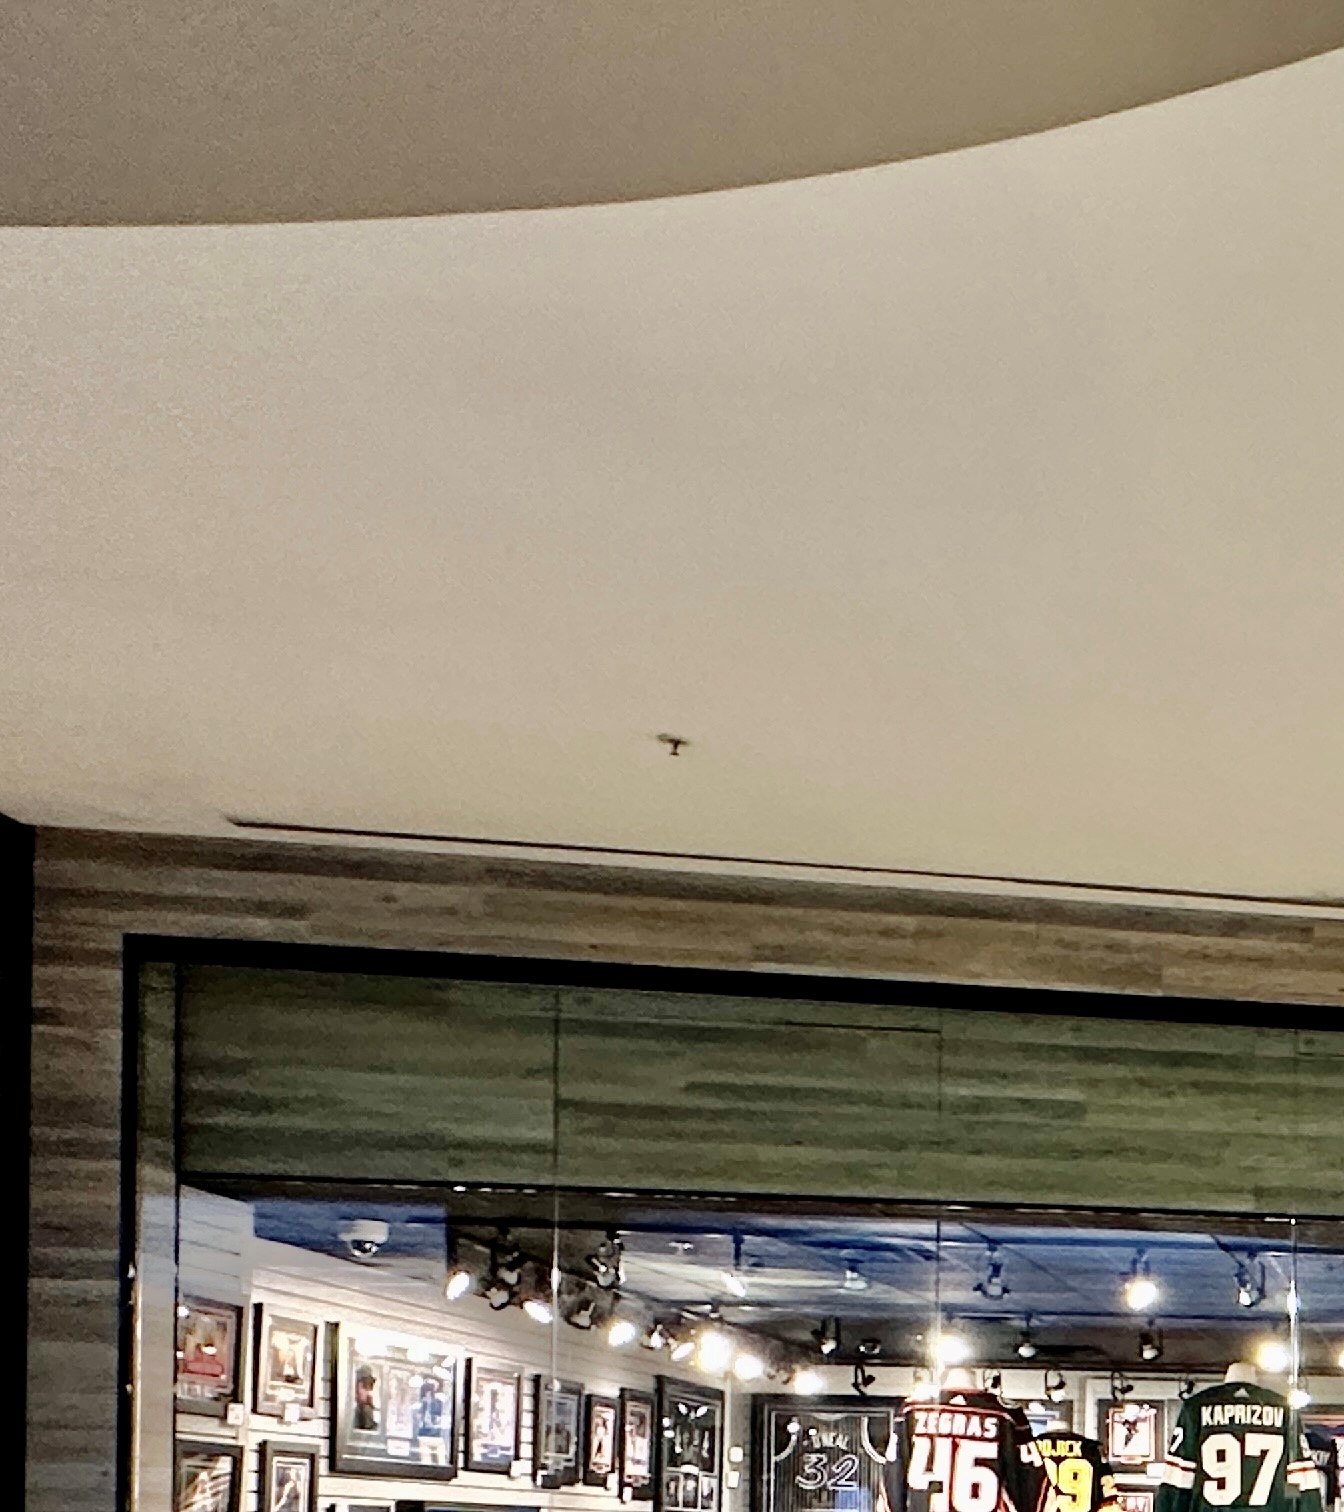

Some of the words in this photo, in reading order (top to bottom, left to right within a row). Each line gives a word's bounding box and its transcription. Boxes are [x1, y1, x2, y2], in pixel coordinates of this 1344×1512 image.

[914, 1411, 998, 1438] ZEGRAS
[1202, 1405, 1284, 1428] KAPRIZOV
[795, 1452, 860, 1490] 32
[1202, 1433, 1285, 1506] 97
